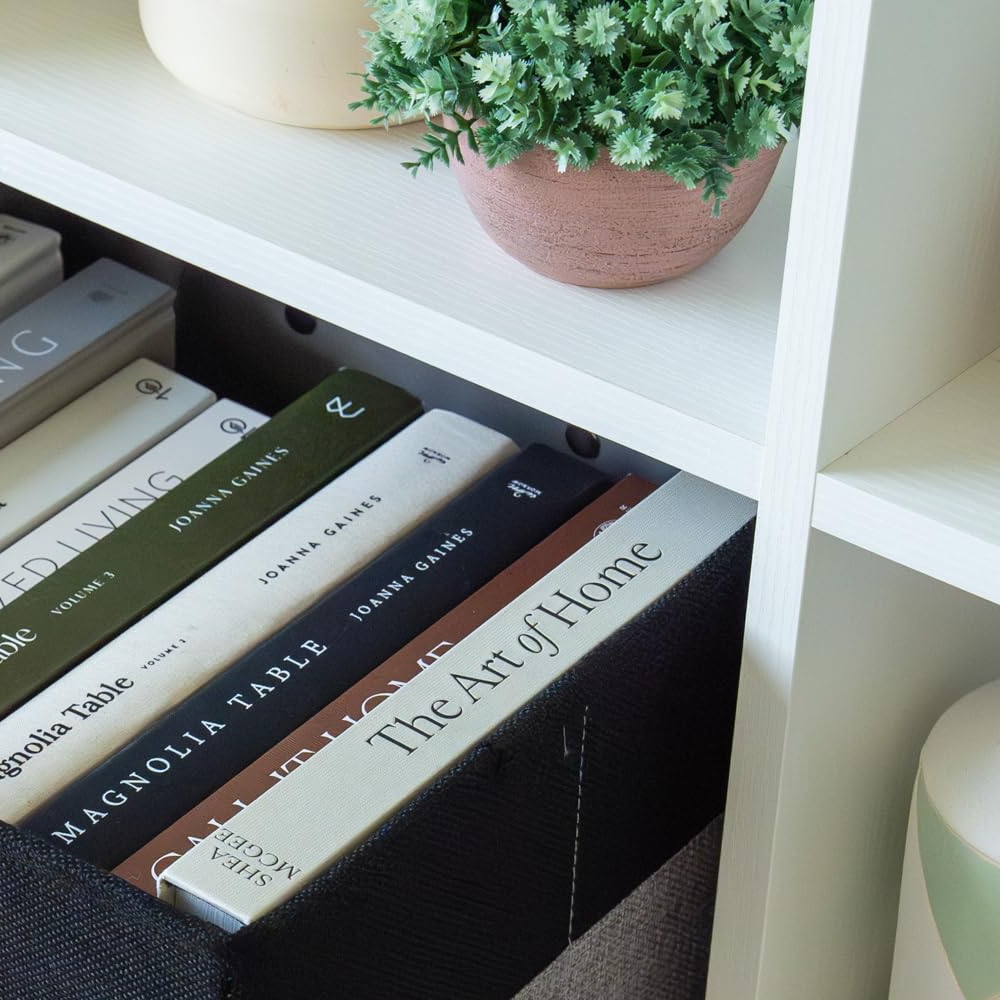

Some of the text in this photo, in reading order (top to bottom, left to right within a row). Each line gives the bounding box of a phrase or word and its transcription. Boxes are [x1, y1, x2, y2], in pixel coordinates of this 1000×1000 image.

[56, 470, 185, 554] LIVING
[168, 446, 290, 533] JOANNA GAINES
[258, 494, 382, 585] JOANNA GAINES
[50, 571, 116, 617] VOLUME 3
[349, 526, 474, 622] JOANNA GAINES
[533, 542, 663, 629] Home
[139, 643, 180, 671] VOLUME
[517, 613, 560, 658] of
[61, 675, 135, 721] Table
[449, 649, 525, 705] Art
[51, 717, 227, 846] MAGNOLIA
[227, 639, 328, 710] TABLE
[366, 698, 463, 756] The
[210, 846, 273, 887] SHEA
[214, 828, 302, 880] MCGEE
